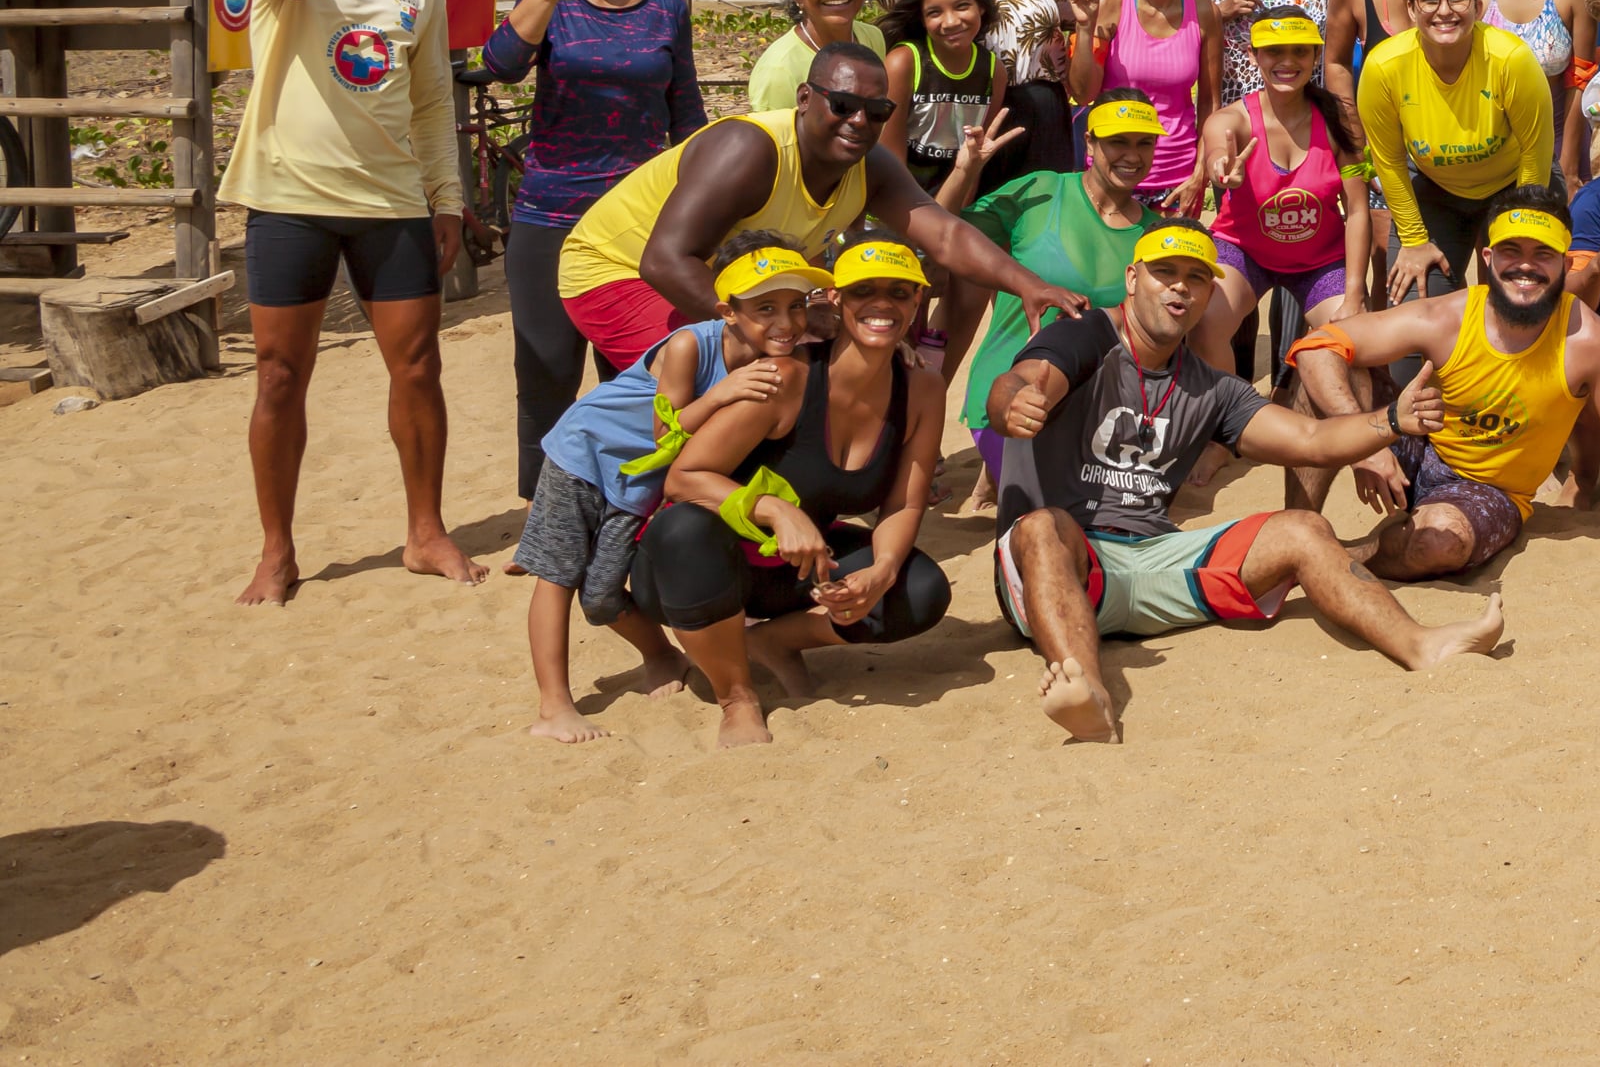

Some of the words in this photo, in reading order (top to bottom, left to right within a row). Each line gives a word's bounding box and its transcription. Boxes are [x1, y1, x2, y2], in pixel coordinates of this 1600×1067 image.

[929, 94, 951, 102] LOVE
[954, 94, 981, 104] LOVE
[927, 148, 953, 158] LOVE
[1265, 209, 1317, 228] BOX
